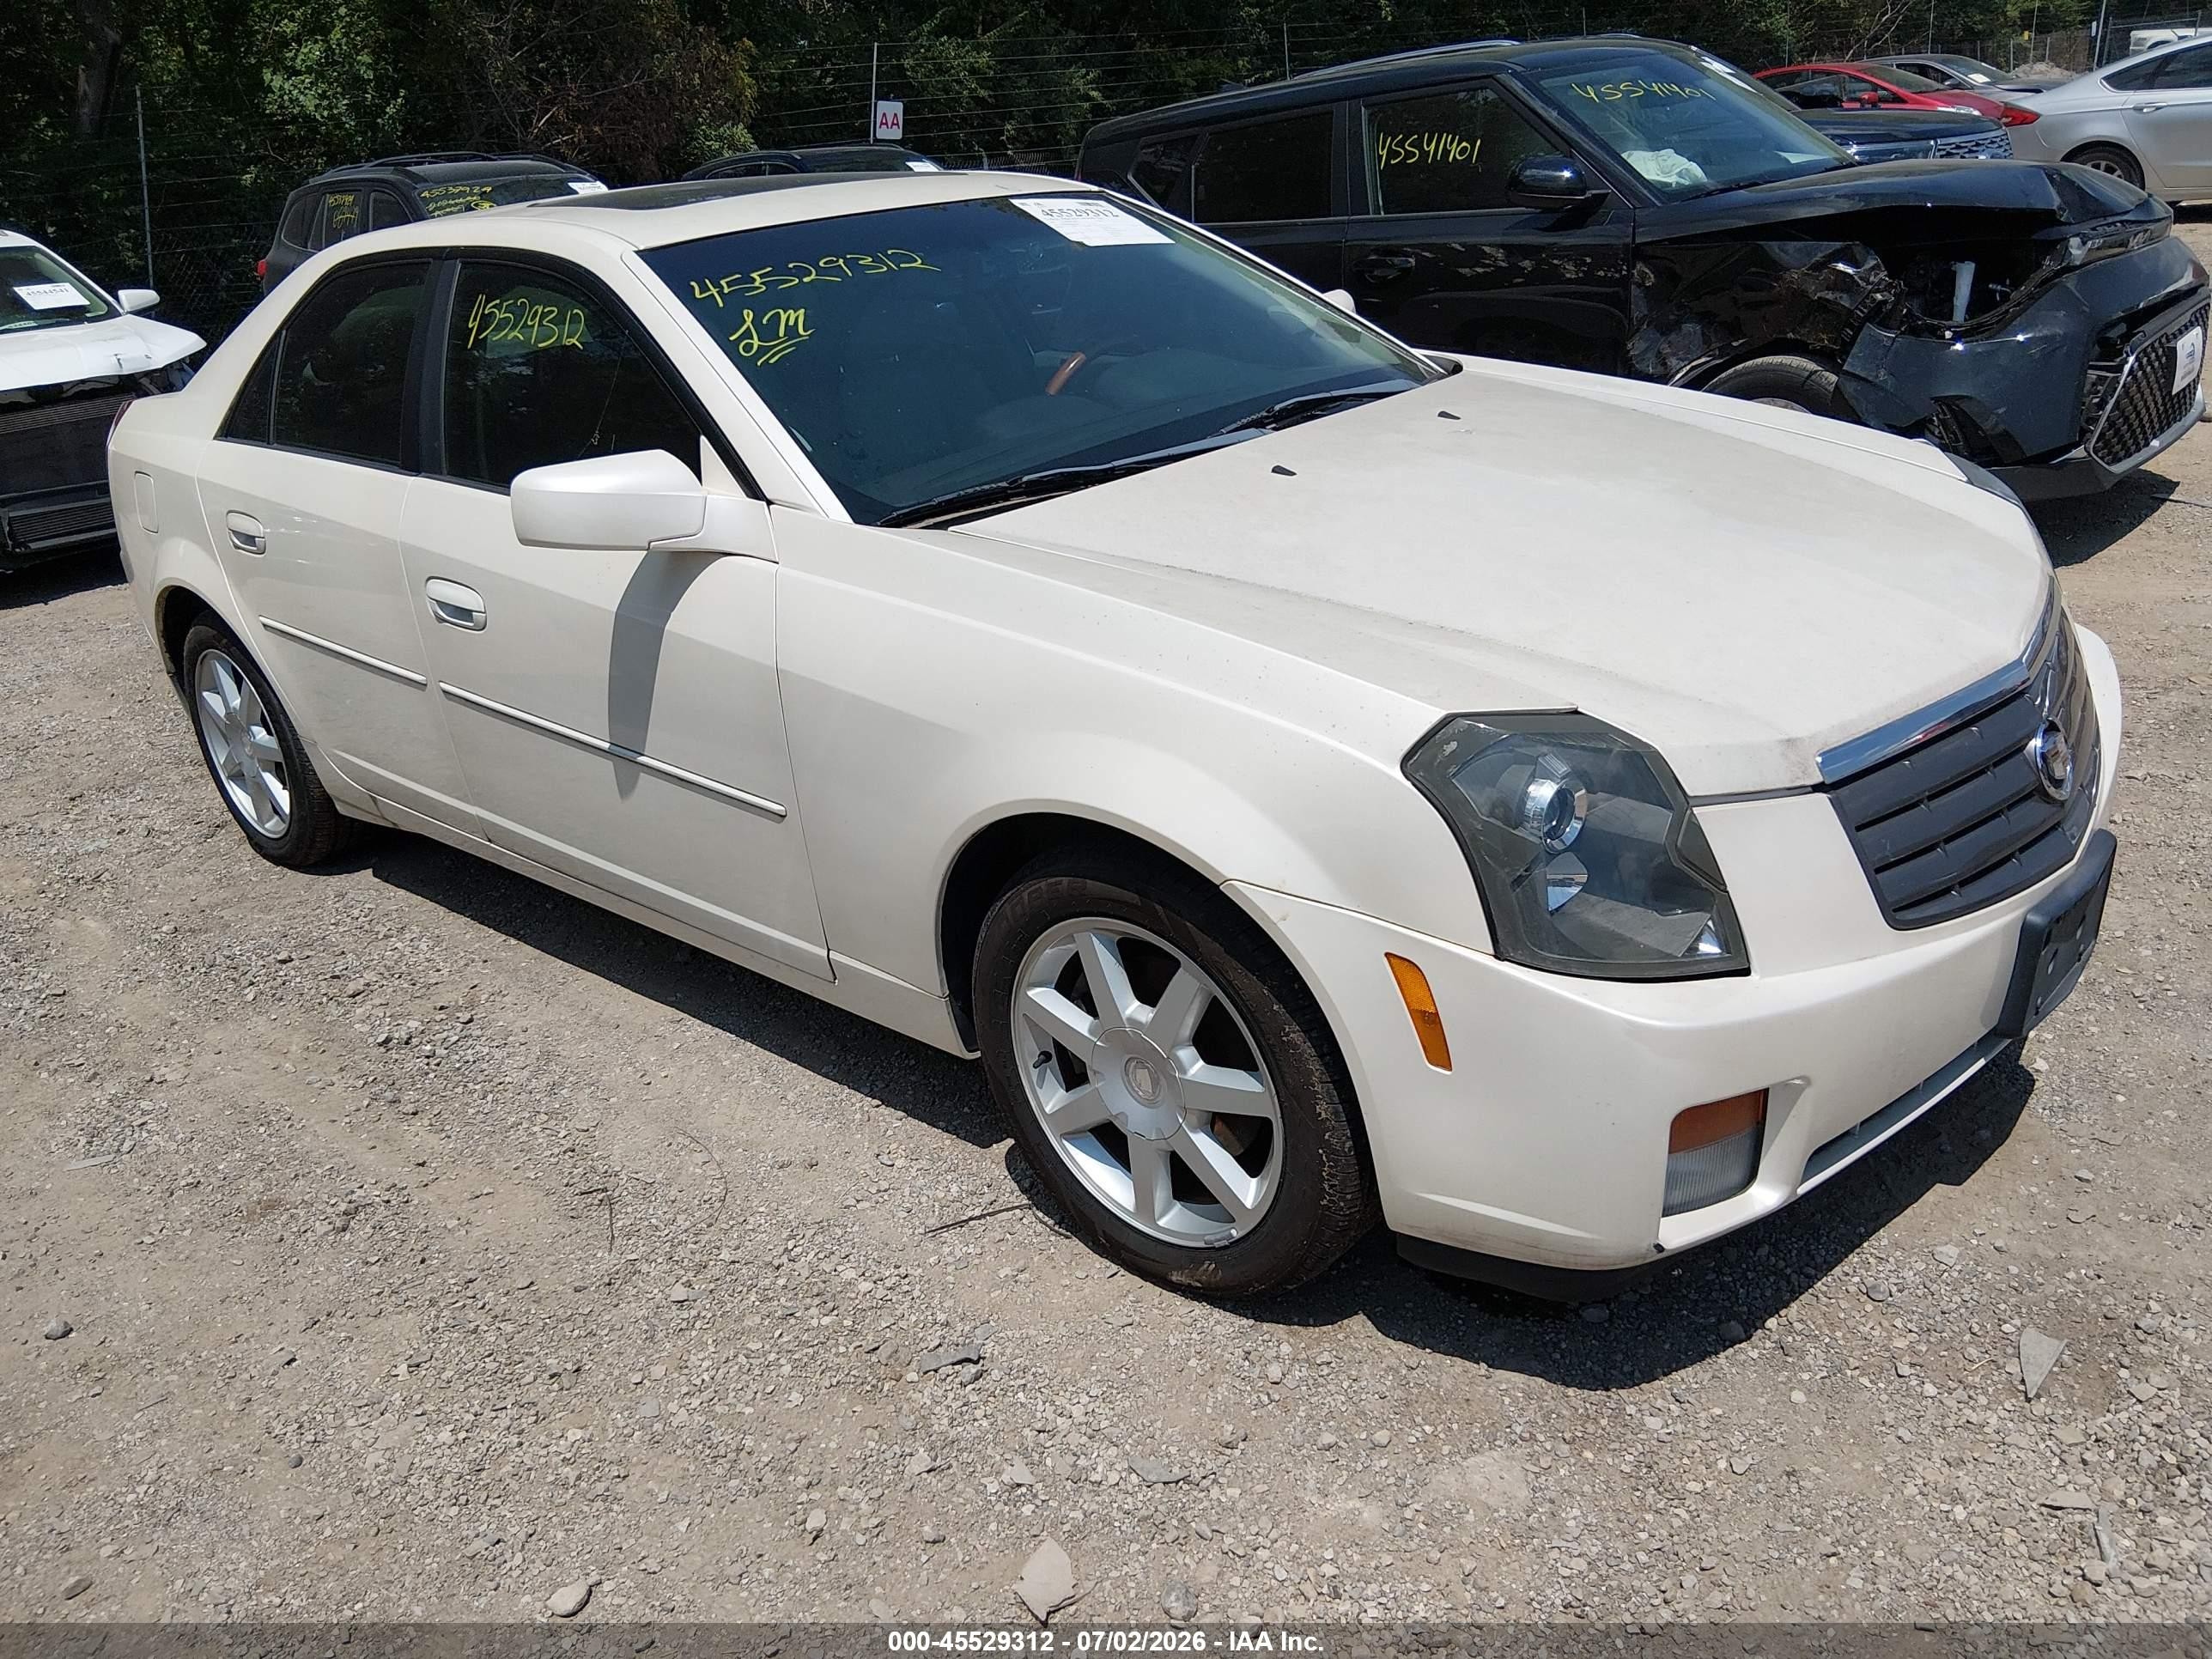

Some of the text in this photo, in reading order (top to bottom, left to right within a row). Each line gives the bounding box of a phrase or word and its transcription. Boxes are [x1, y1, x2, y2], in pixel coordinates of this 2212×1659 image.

[1571, 79, 1717, 102] 45541401
[878, 112, 901, 130] AA
[1376, 131, 1481, 170] 45541401
[1041, 209, 1120, 218] 45529312
[690, 249, 942, 308] 45529312
[466, 293, 585, 350] 45529312
